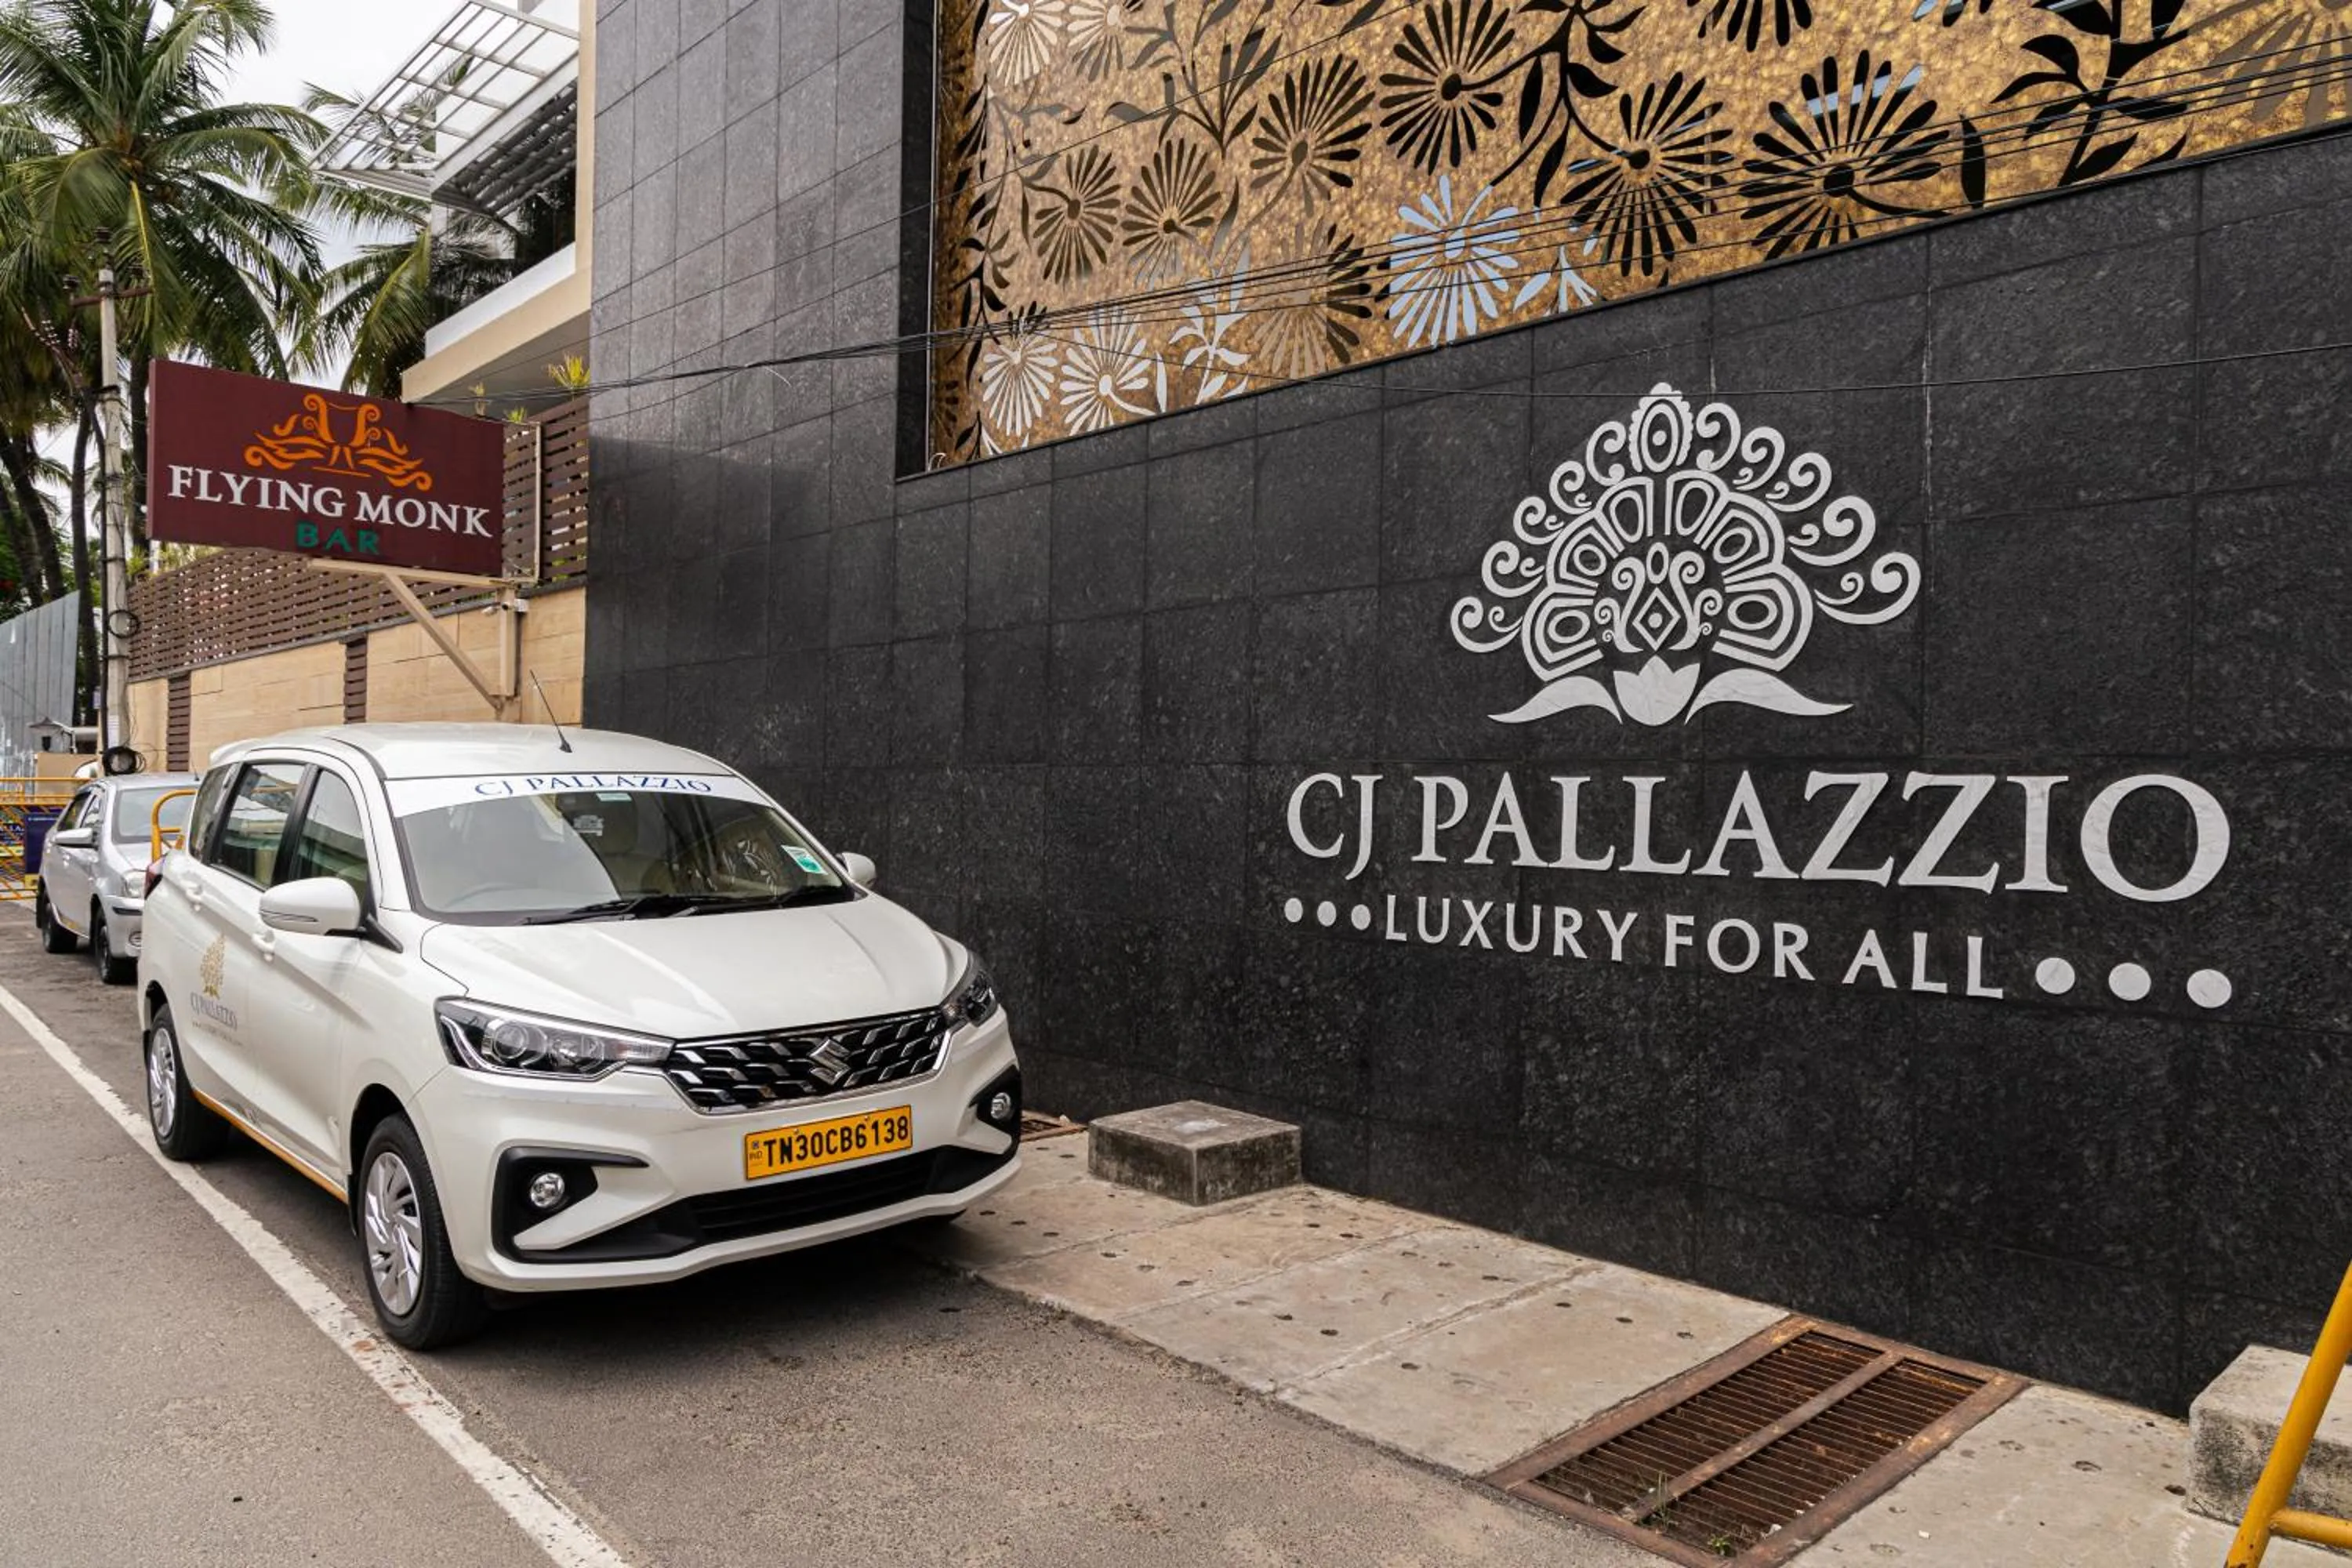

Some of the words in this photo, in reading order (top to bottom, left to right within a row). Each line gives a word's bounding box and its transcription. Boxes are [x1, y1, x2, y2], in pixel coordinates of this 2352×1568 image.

[167, 463, 347, 517] FLYING
[354, 490, 494, 539] MONK
[296, 520, 381, 555] BAR
[474, 779, 514, 796] CJ
[526, 773, 713, 793] PALLAZZIO
[1287, 771, 1384, 881] CJ
[1412, 769, 2231, 903] PALLAZZIO
[1385, 894, 1639, 962] LUXURY
[1664, 914, 1816, 982] FOR
[1841, 928, 2004, 1000] ALL
[764, 1115, 909, 1167] TN30CB6138
